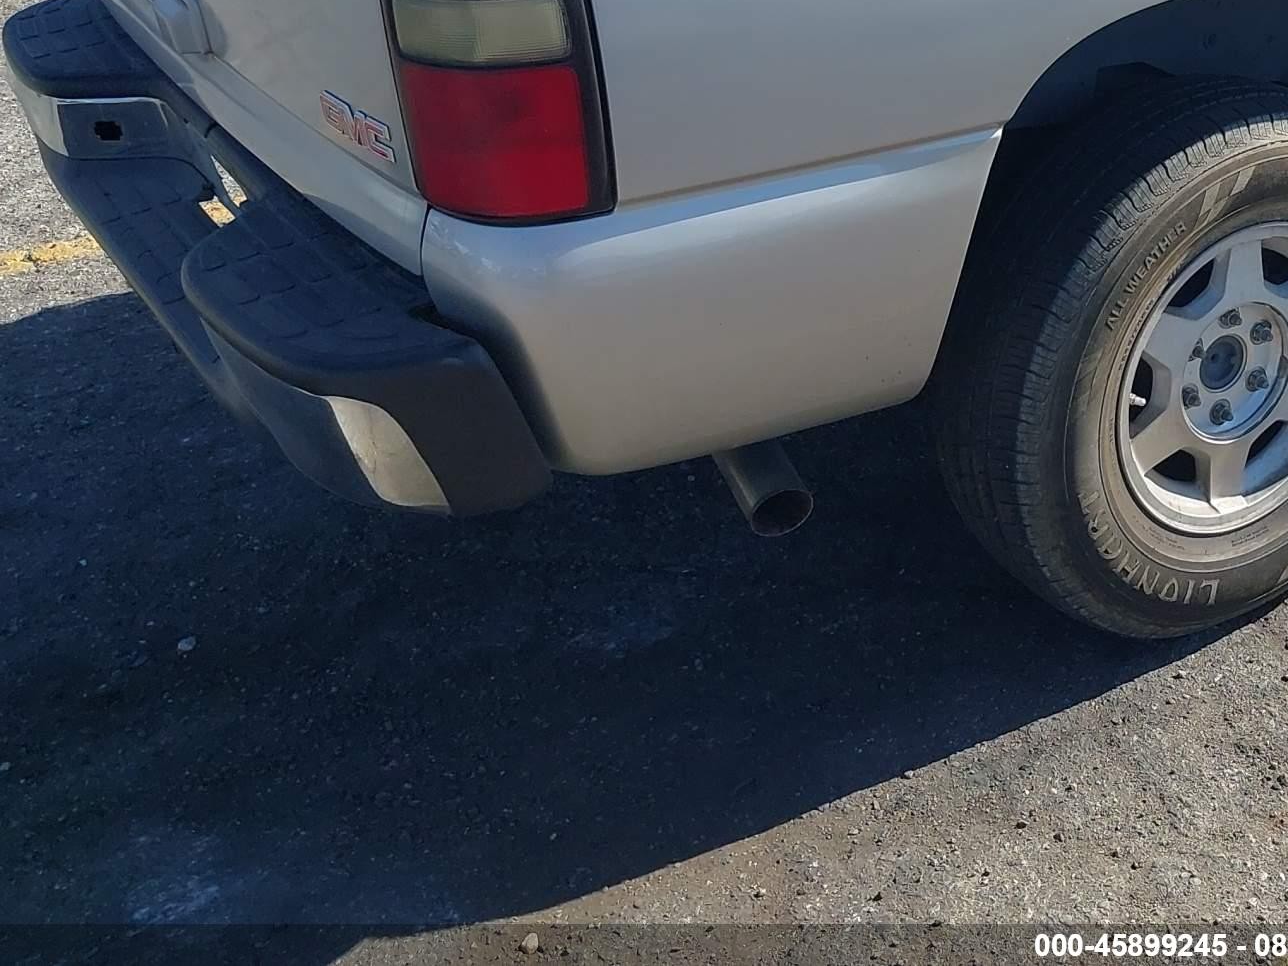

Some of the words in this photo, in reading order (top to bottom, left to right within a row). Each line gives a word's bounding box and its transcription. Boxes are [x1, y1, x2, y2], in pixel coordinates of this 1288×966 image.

[319, 89, 397, 163] GMC
[1105, 297, 1130, 331] ALL
[1123, 221, 1188, 295] WEATHER
[1078, 491, 1220, 606] LIONHART
